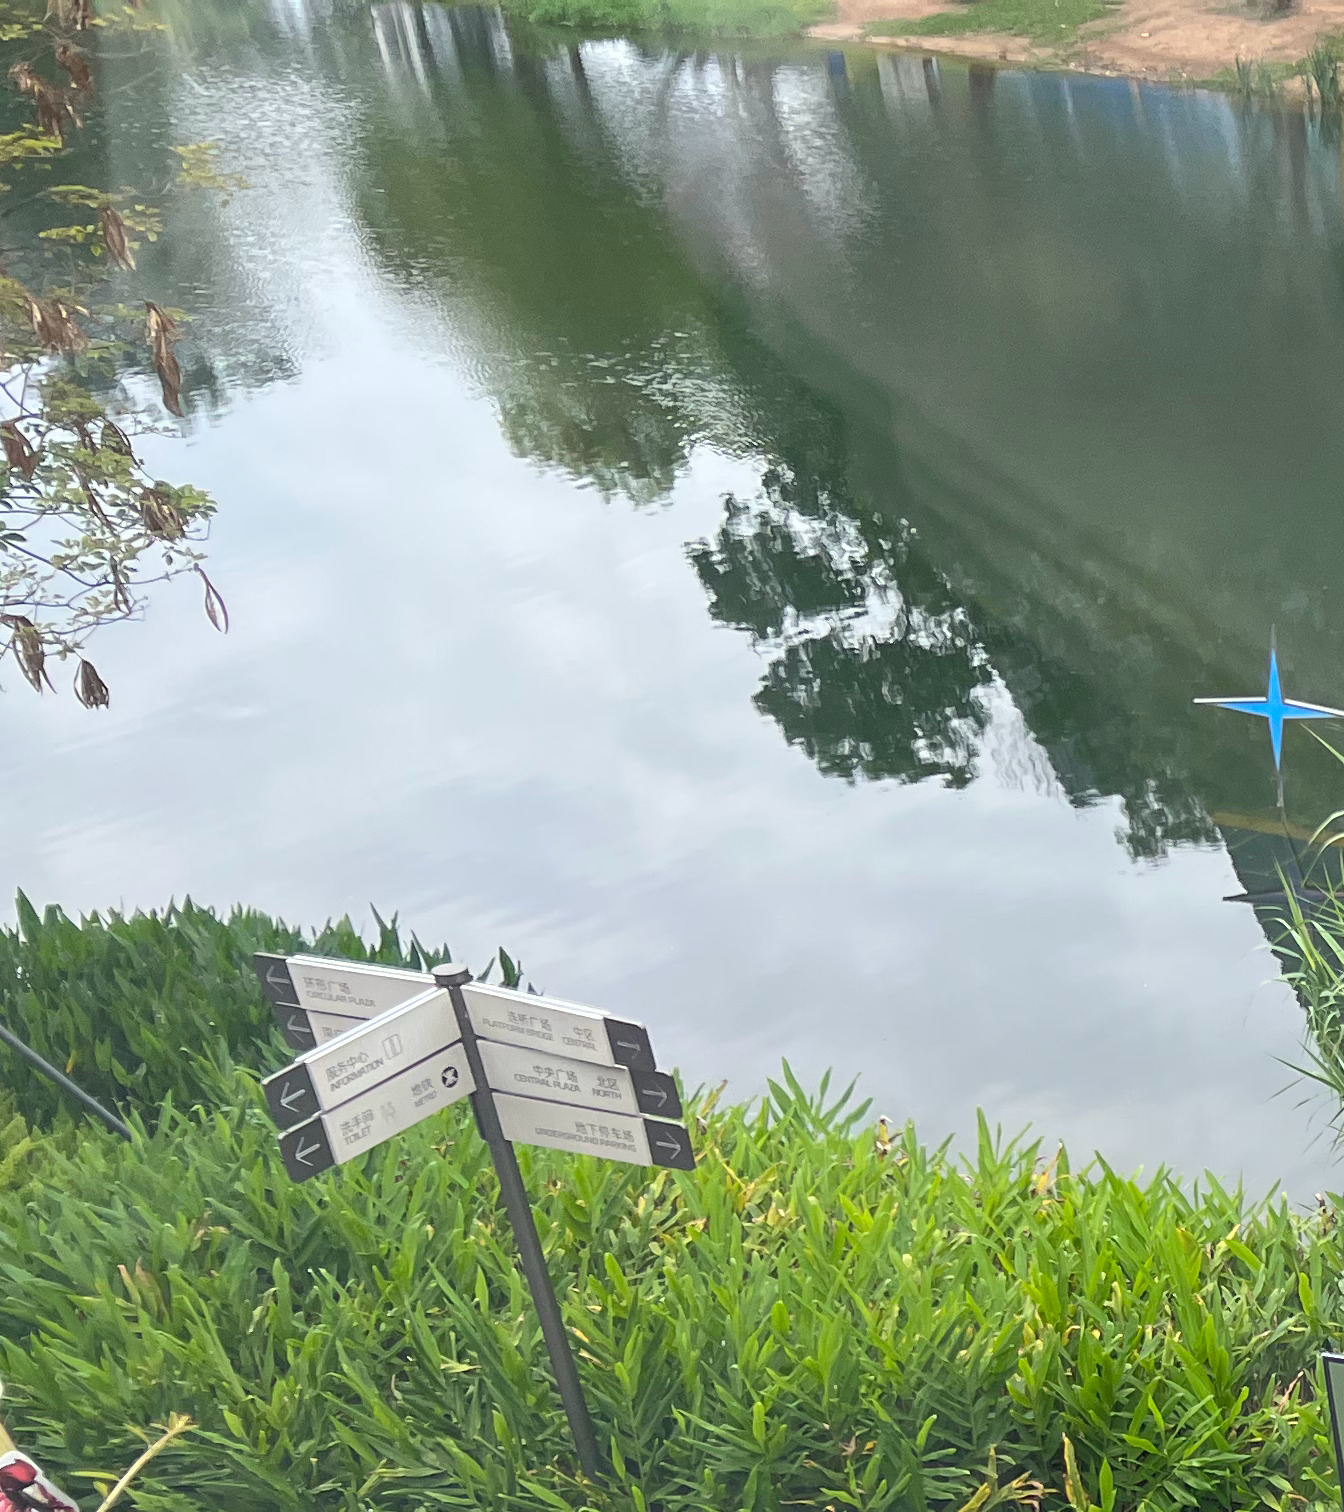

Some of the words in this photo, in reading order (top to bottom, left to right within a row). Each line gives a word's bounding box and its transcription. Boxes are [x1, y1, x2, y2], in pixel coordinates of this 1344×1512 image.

[330, 1058, 384, 1092] INFORMATION
[513, 1073, 552, 1087] CENTRAL
[553, 1080, 581, 1093] PLAZA
[592, 1087, 622, 1100] NORTH
[344, 1126, 371, 1145] TOILET
